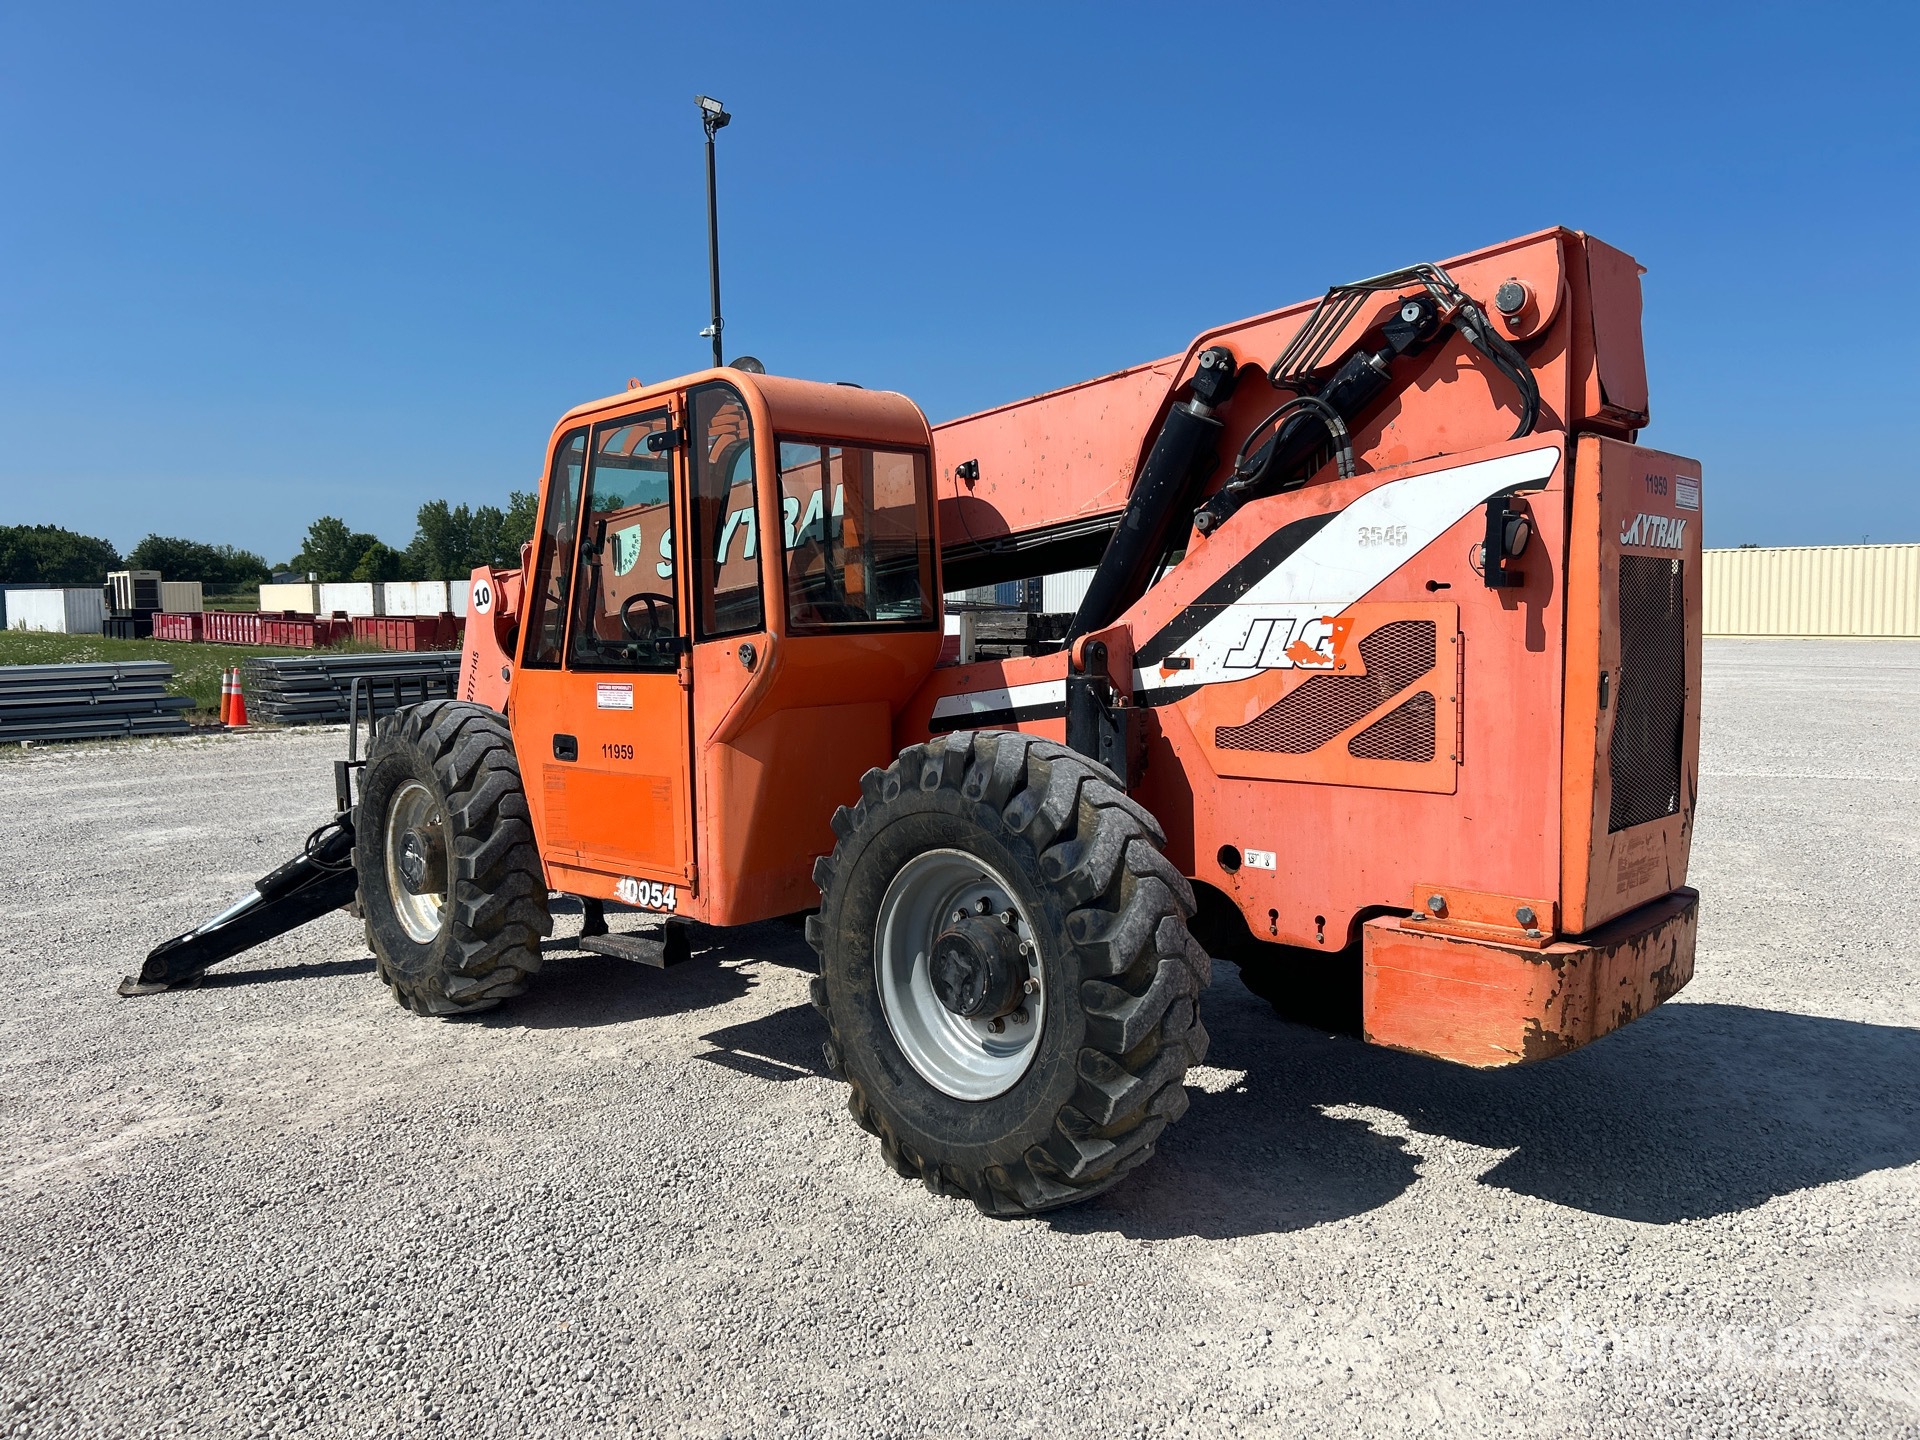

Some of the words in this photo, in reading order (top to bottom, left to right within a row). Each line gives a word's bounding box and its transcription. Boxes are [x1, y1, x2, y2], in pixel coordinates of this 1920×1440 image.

[1645, 474, 1668, 496] 11959
[474, 587, 490, 606] 10
[1223, 618, 1338, 670] JLG
[467, 651, 479, 702] 2777-145
[602, 744, 634, 760] 11959
